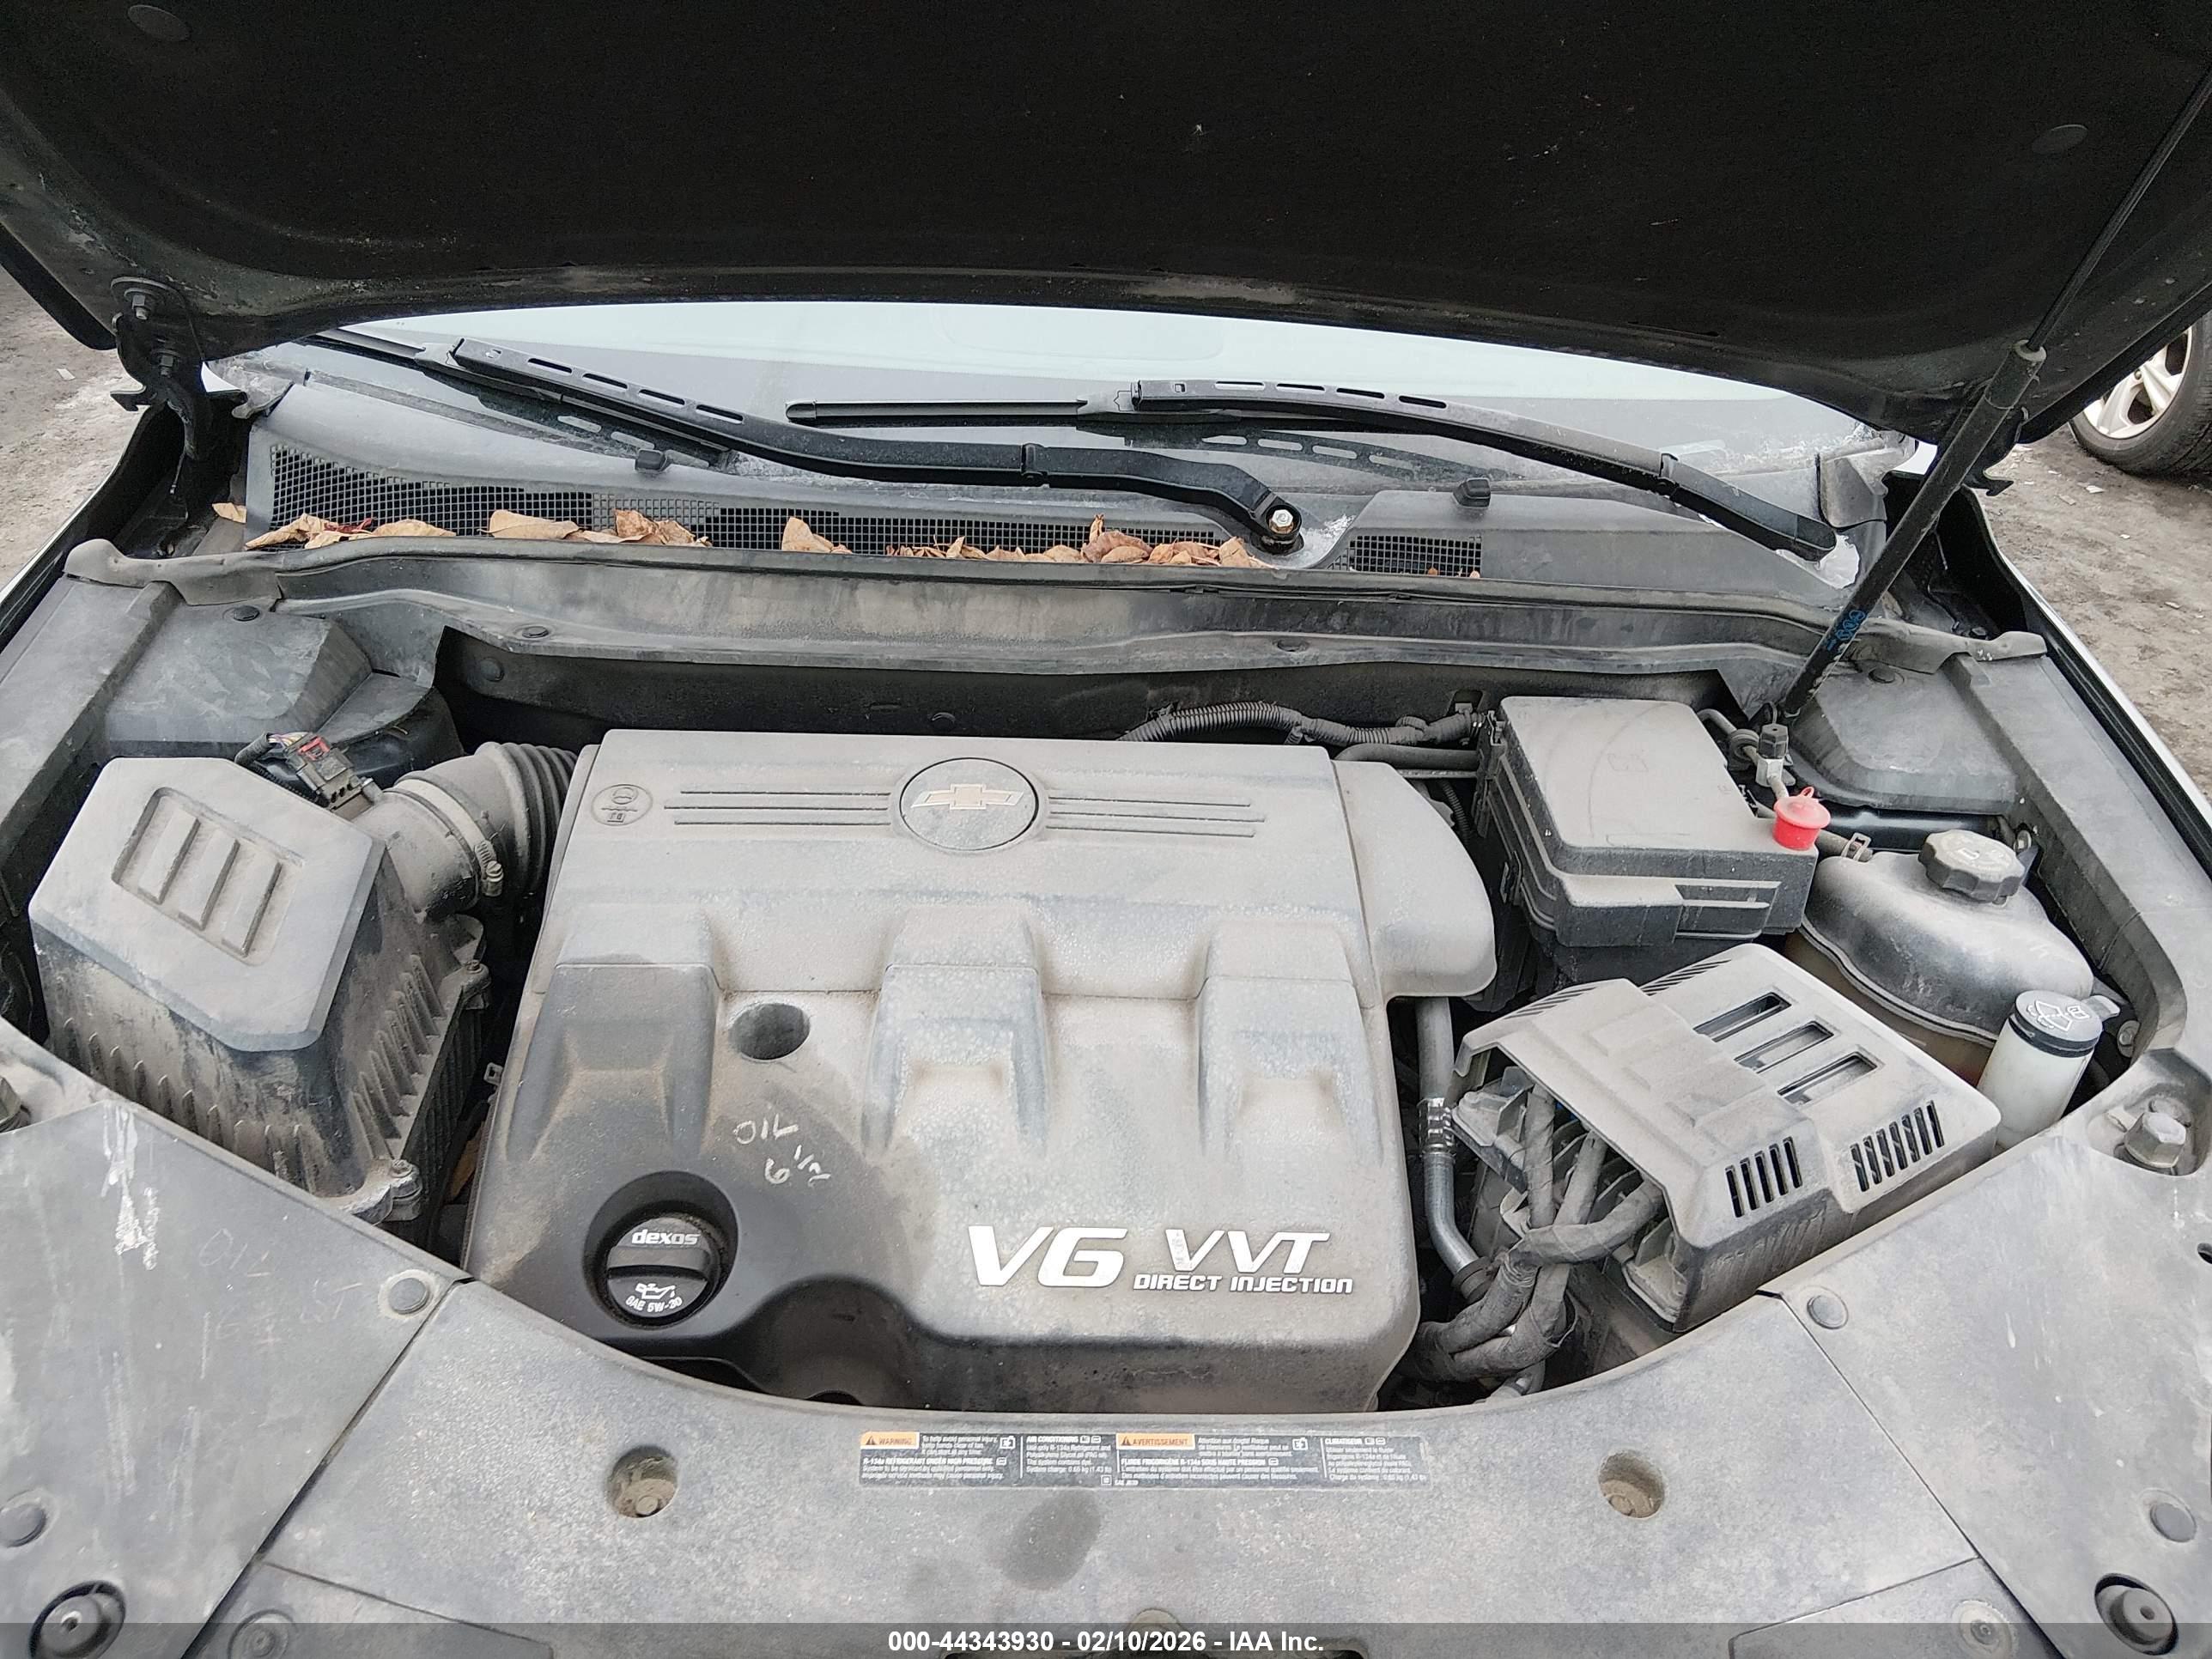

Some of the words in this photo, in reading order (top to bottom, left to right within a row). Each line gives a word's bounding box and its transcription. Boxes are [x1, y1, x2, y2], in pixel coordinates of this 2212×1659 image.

[733, 1114, 799, 1145] OIL
[631, 1229, 701, 1245] dexos
[968, 1225, 1128, 1288] V6
[1164, 1229, 1331, 1274] VVT
[1133, 1274, 1223, 1291] DIRECT
[1230, 1276, 1353, 1295] INJECTION
[1133, 1437, 1188, 1446] AVERTISSEMENT
